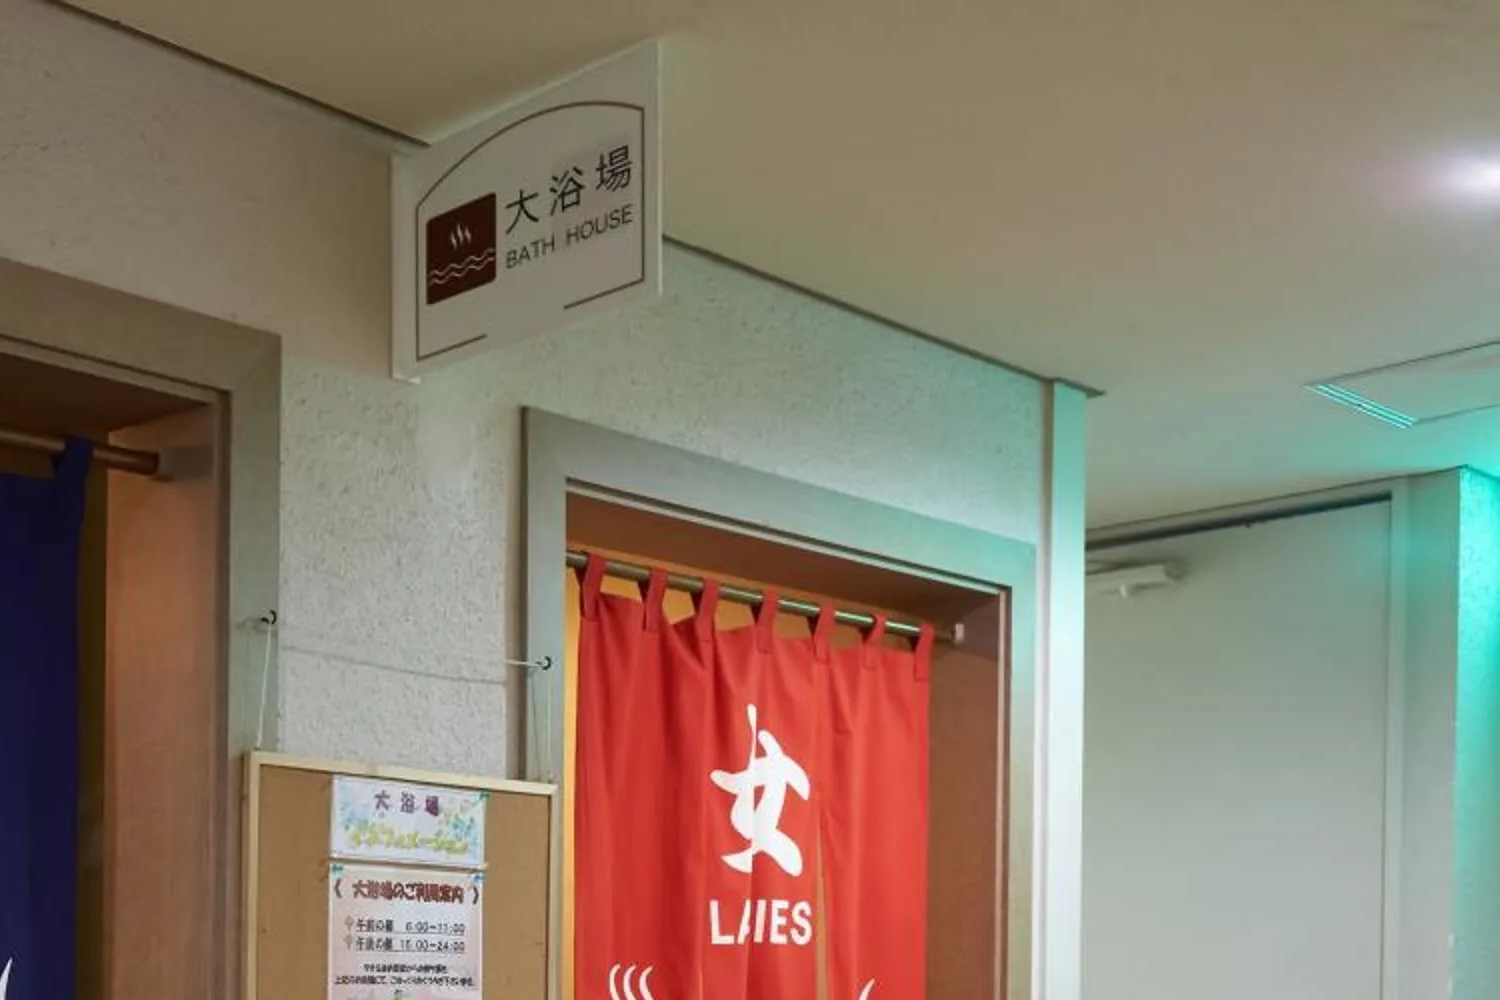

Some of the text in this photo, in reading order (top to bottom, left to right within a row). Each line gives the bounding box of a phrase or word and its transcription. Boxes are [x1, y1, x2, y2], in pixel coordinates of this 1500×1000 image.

[504, 144, 633, 235] 大浴場
[505, 204, 633, 269] BATH HOUSE
[373, 789, 439, 816] 大浴場
[710, 704, 811, 877] 女
[709, 899, 812, 945] LIES
